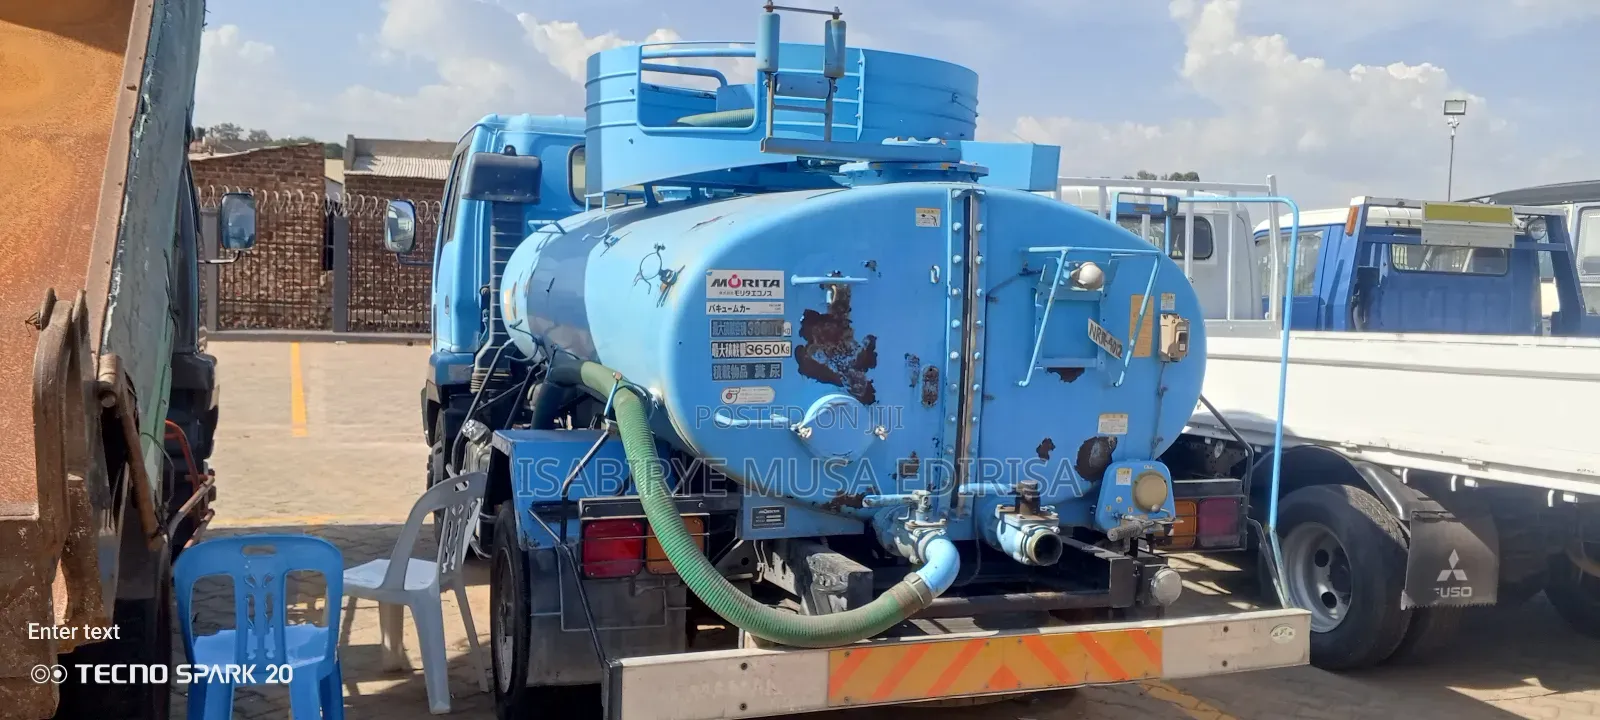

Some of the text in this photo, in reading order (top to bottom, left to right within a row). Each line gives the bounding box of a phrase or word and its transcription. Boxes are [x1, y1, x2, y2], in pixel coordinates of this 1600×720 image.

[708, 304, 751, 313] バキュームカー
